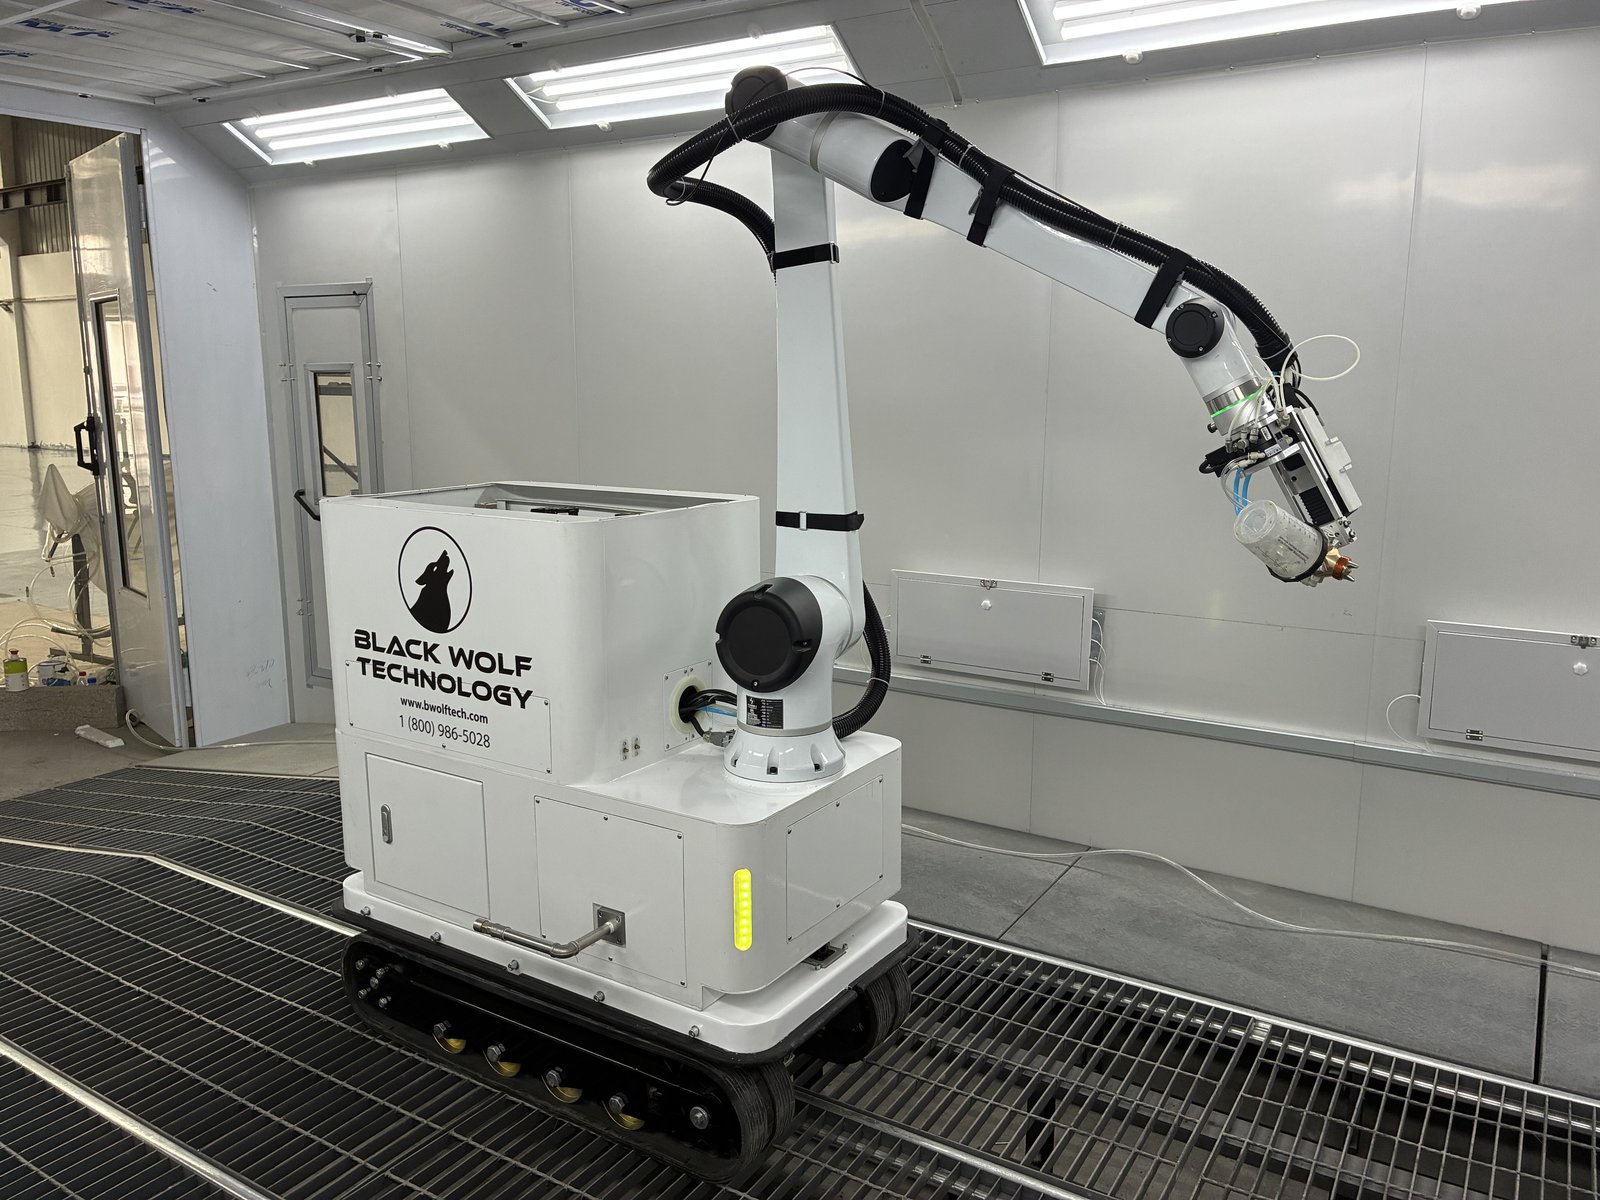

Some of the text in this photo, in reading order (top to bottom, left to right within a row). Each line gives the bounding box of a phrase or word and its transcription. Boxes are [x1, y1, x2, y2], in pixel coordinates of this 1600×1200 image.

[354, 628, 533, 677] BLACK WOLF
[356, 656, 534, 709] TECHNOLOGY
[399, 714, 491, 748] 1 (800) 986-5028
[400, 697, 489, 724] www.bwolftech.com
